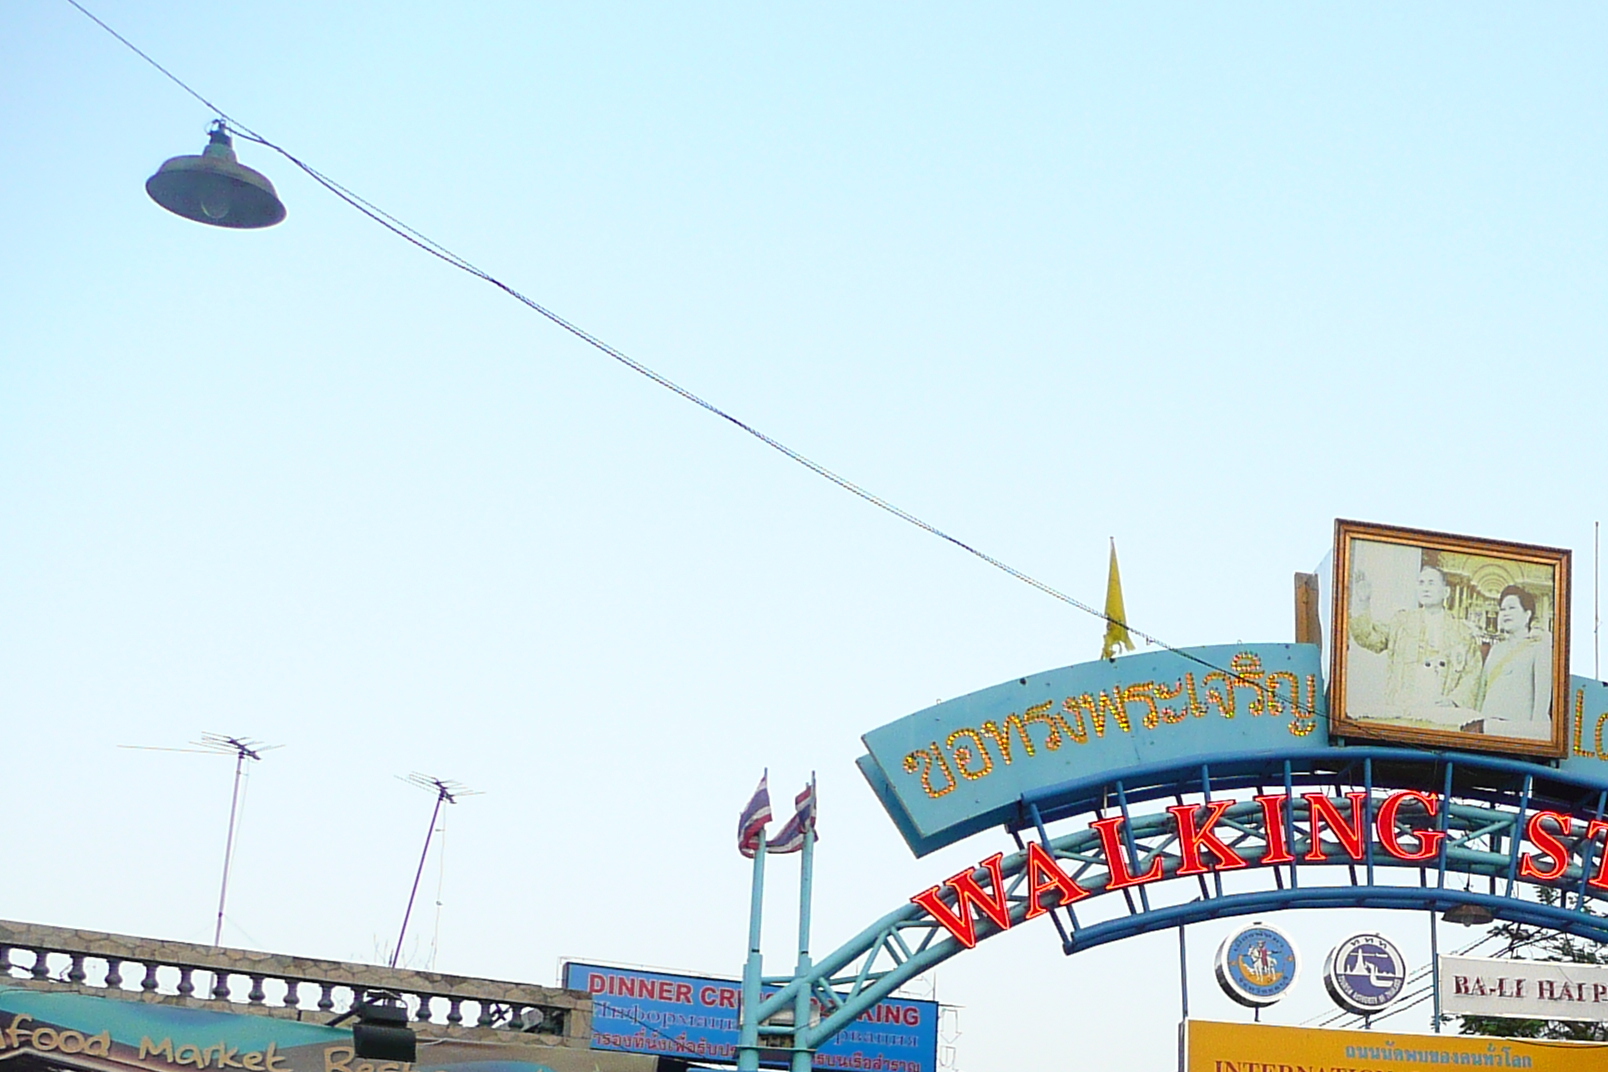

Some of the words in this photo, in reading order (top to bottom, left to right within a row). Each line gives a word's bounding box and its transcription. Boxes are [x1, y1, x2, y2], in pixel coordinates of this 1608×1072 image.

[903, 651, 1317, 798] ขอทรงพระเจริญ
[911, 790, 1447, 949] WALKING
[588, 972, 693, 1005] DINNER
[1453, 974, 1527, 999] BA-LI
[1537, 979, 1587, 1003] HAI
